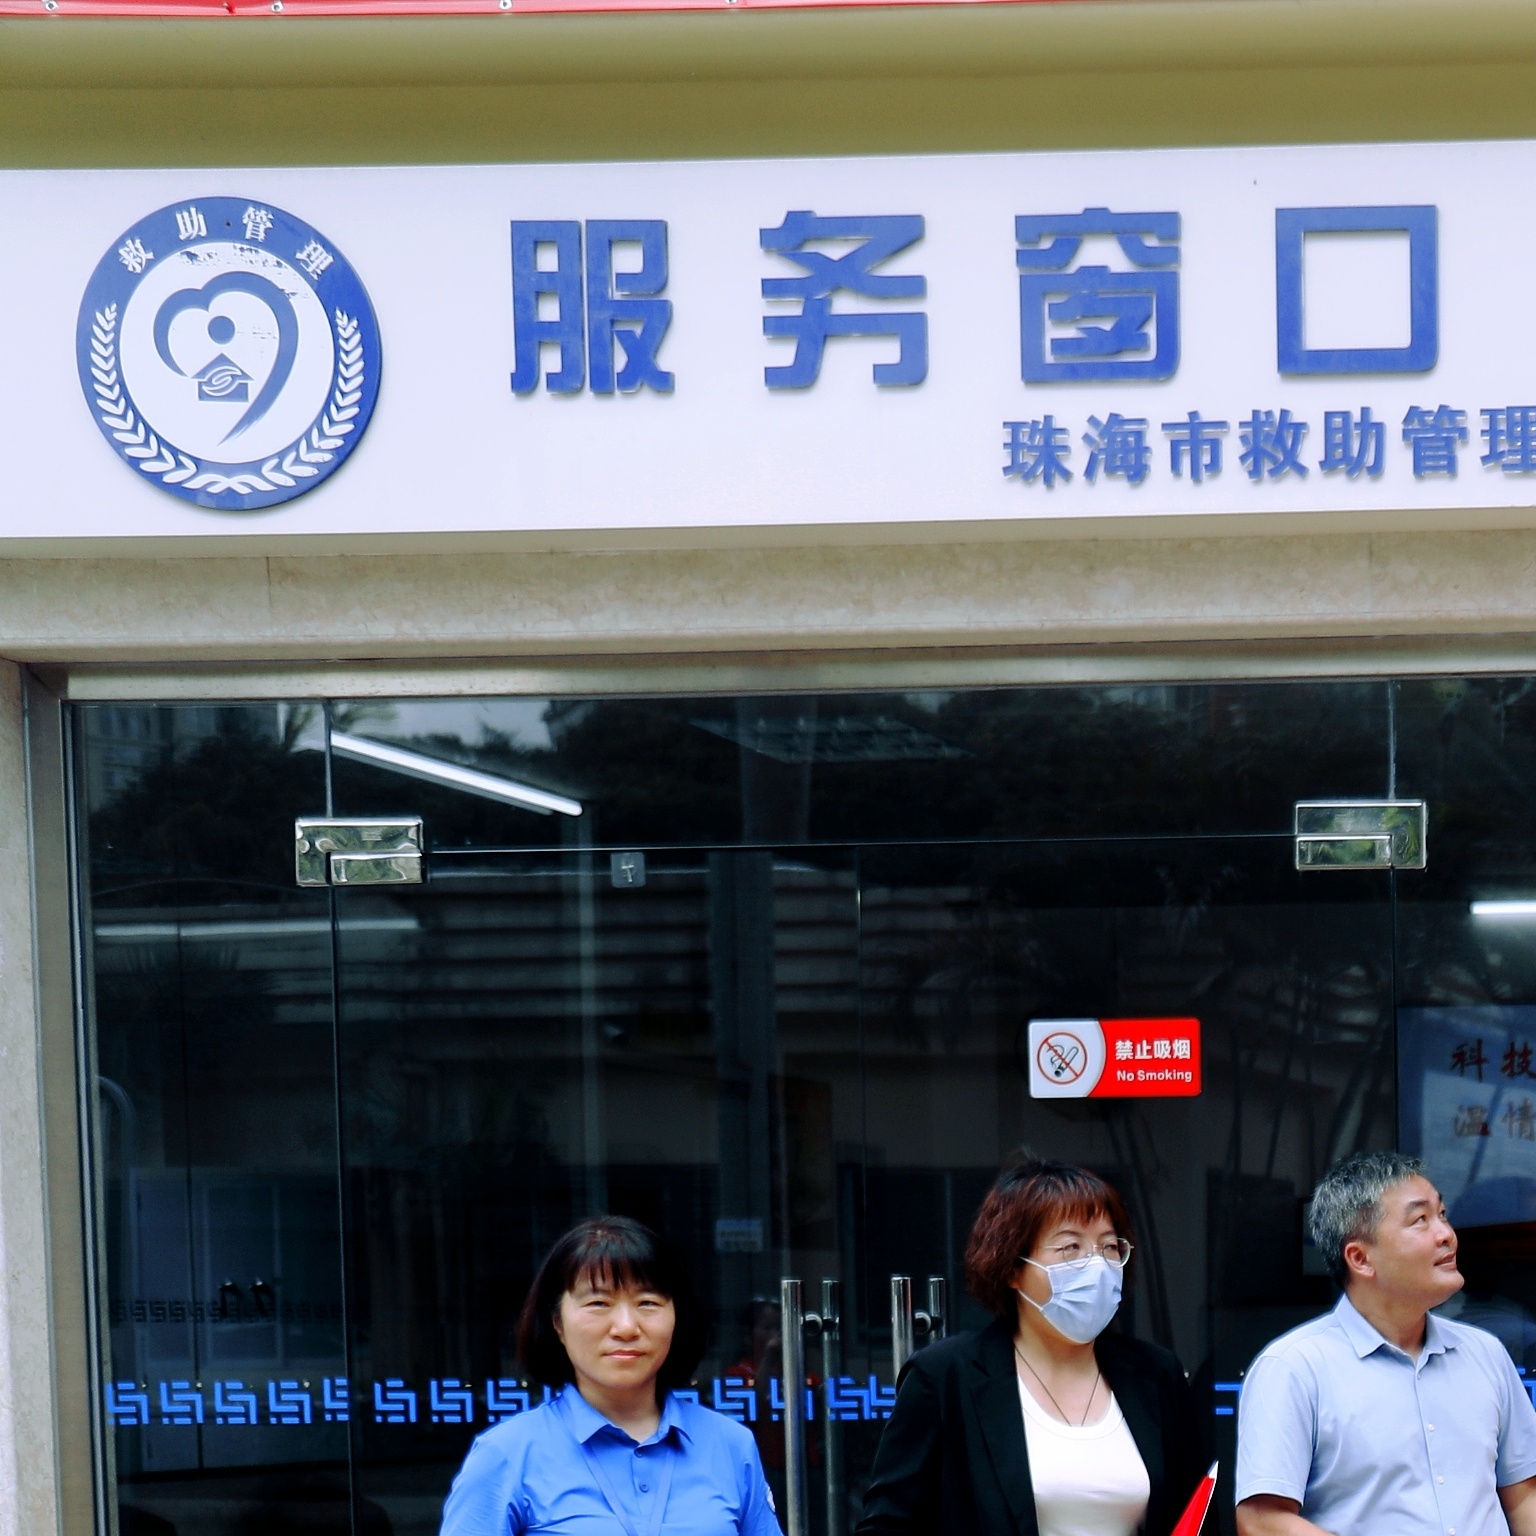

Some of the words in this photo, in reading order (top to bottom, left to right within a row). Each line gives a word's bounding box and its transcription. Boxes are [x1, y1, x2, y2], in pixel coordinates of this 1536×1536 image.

[118, 206, 334, 280] 救助管理
[510, 205, 1439, 397] 服务窗口
[1115, 1040, 1191, 1060] 禁止吸烟
[1117, 1070, 1135, 1082] No
[1138, 1068, 1193, 1083] Smoking
